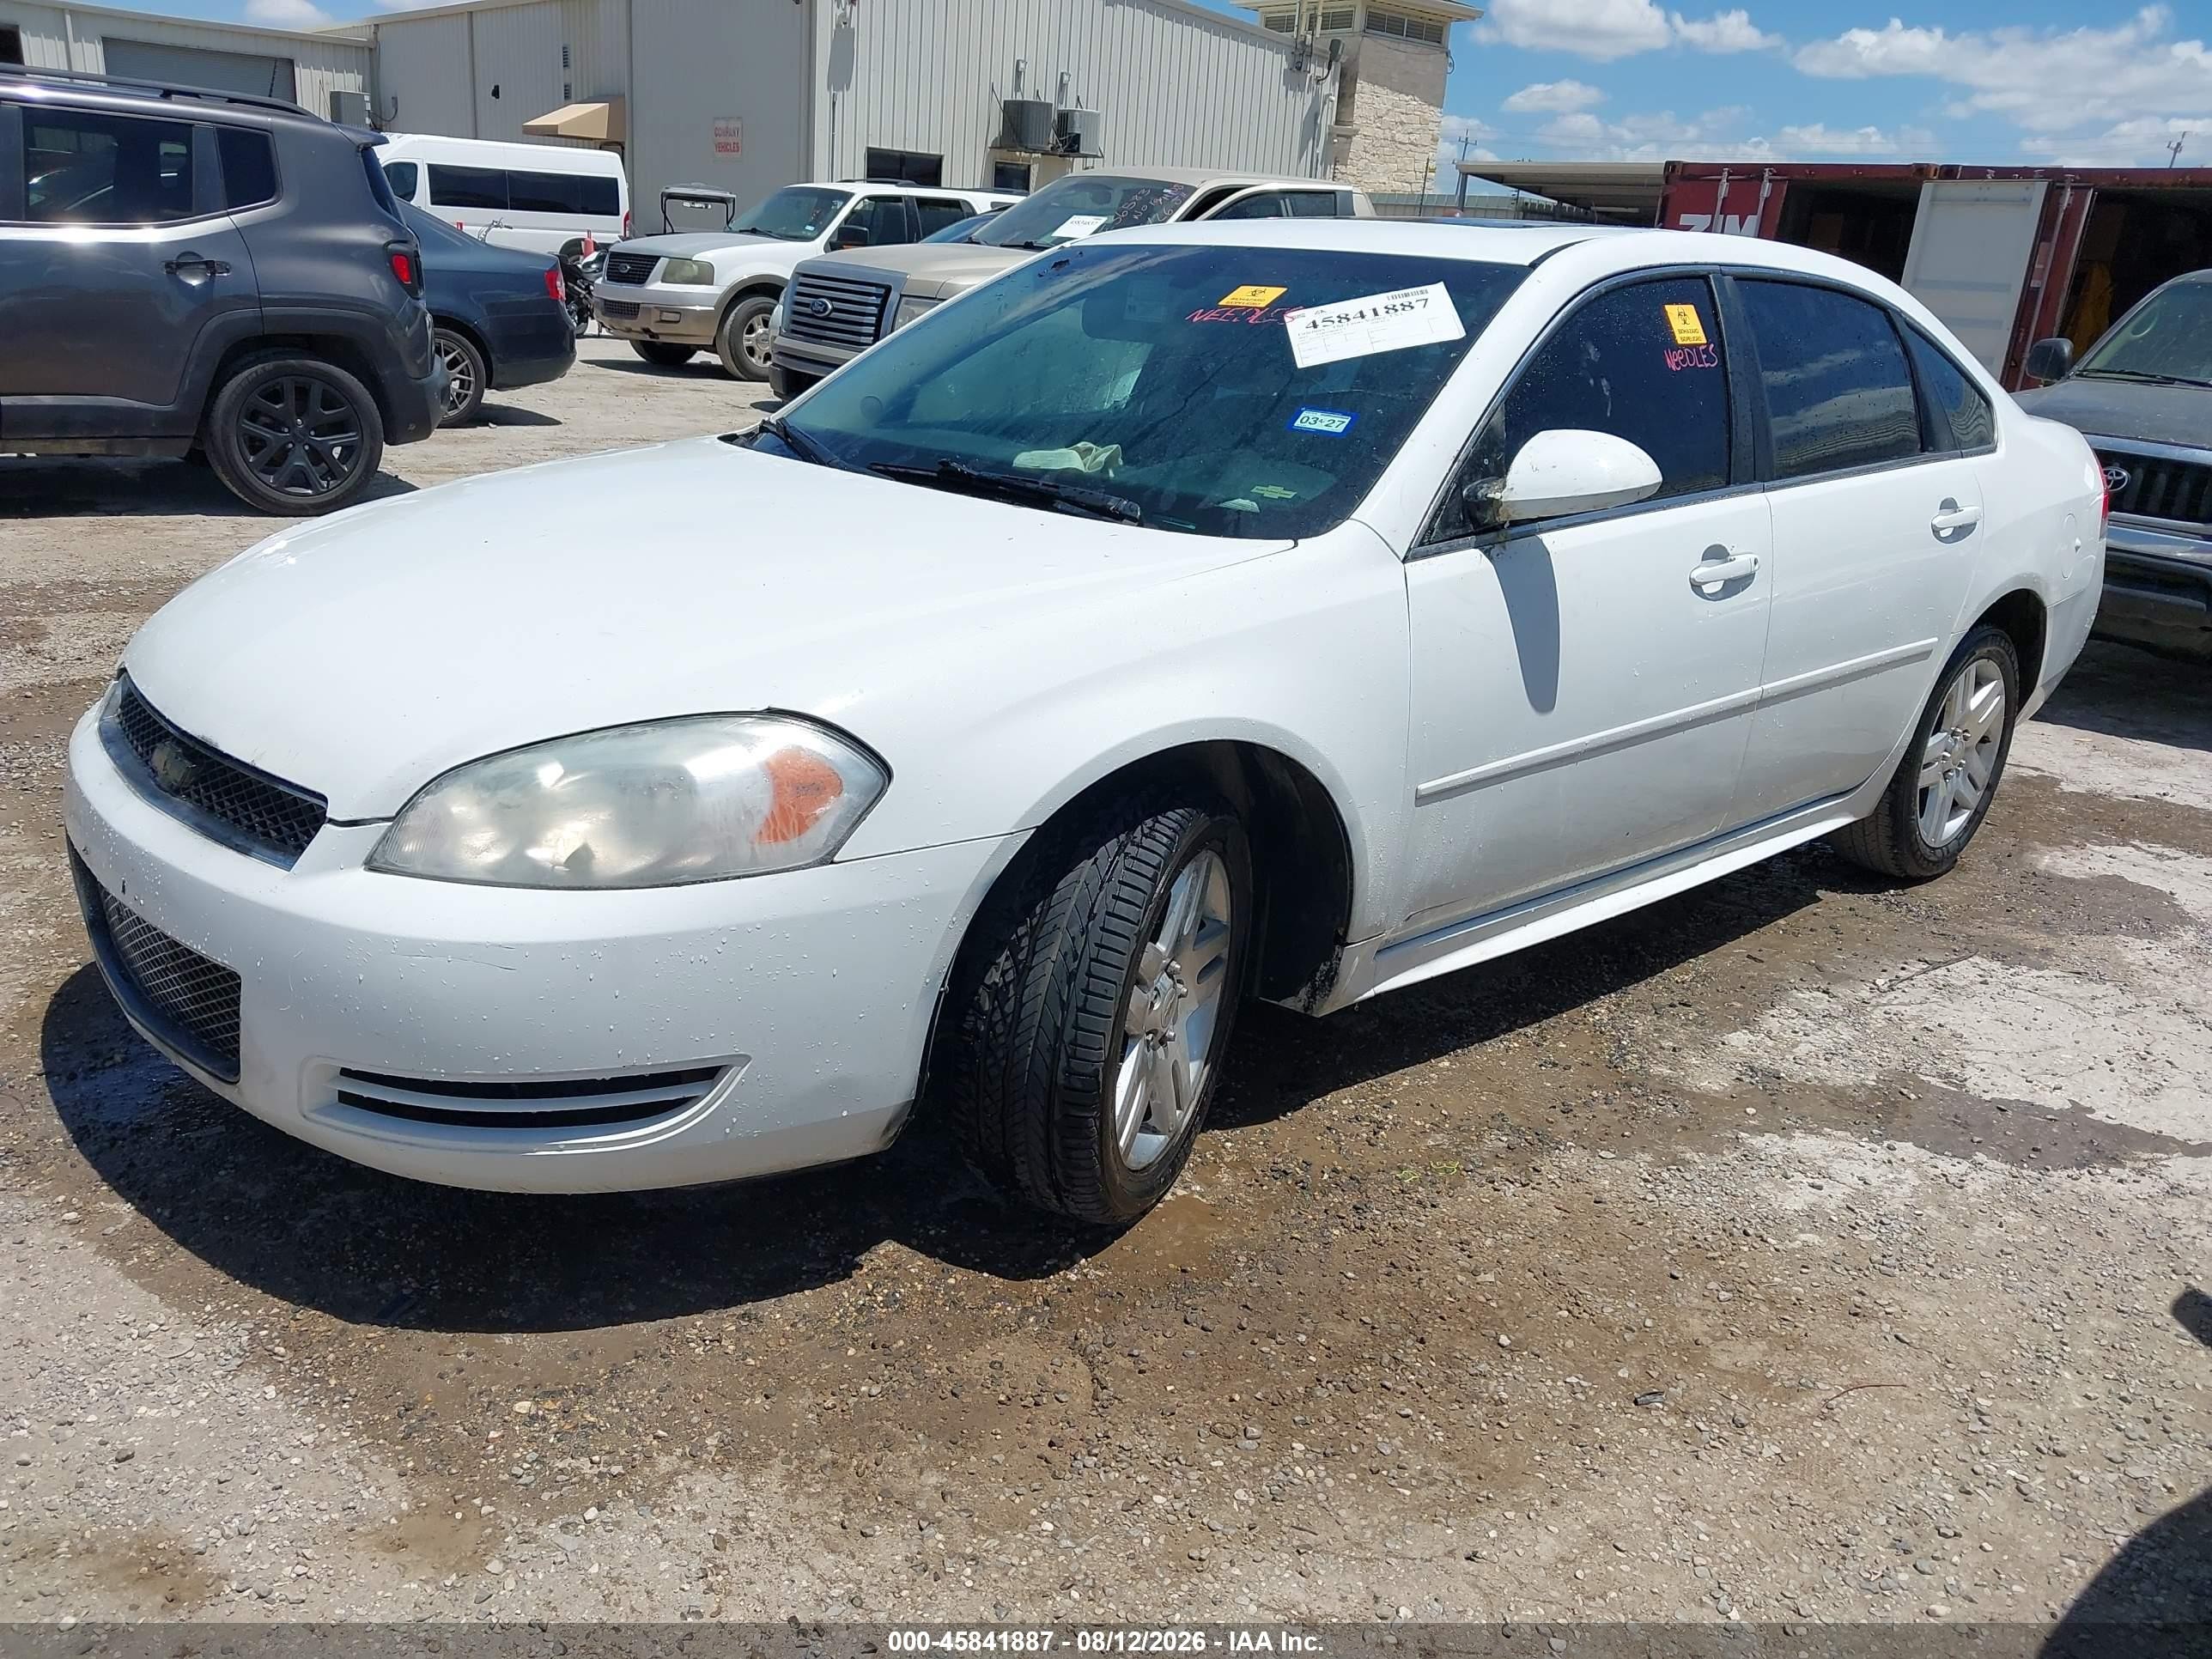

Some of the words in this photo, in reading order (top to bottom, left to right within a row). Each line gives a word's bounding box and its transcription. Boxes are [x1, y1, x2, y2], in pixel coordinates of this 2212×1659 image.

[714, 142, 740, 153] VEHICLES
[1305, 298, 1430, 329] 45841887
[1299, 416, 1320, 425] 03
[1324, 419, 1346, 428] 27
